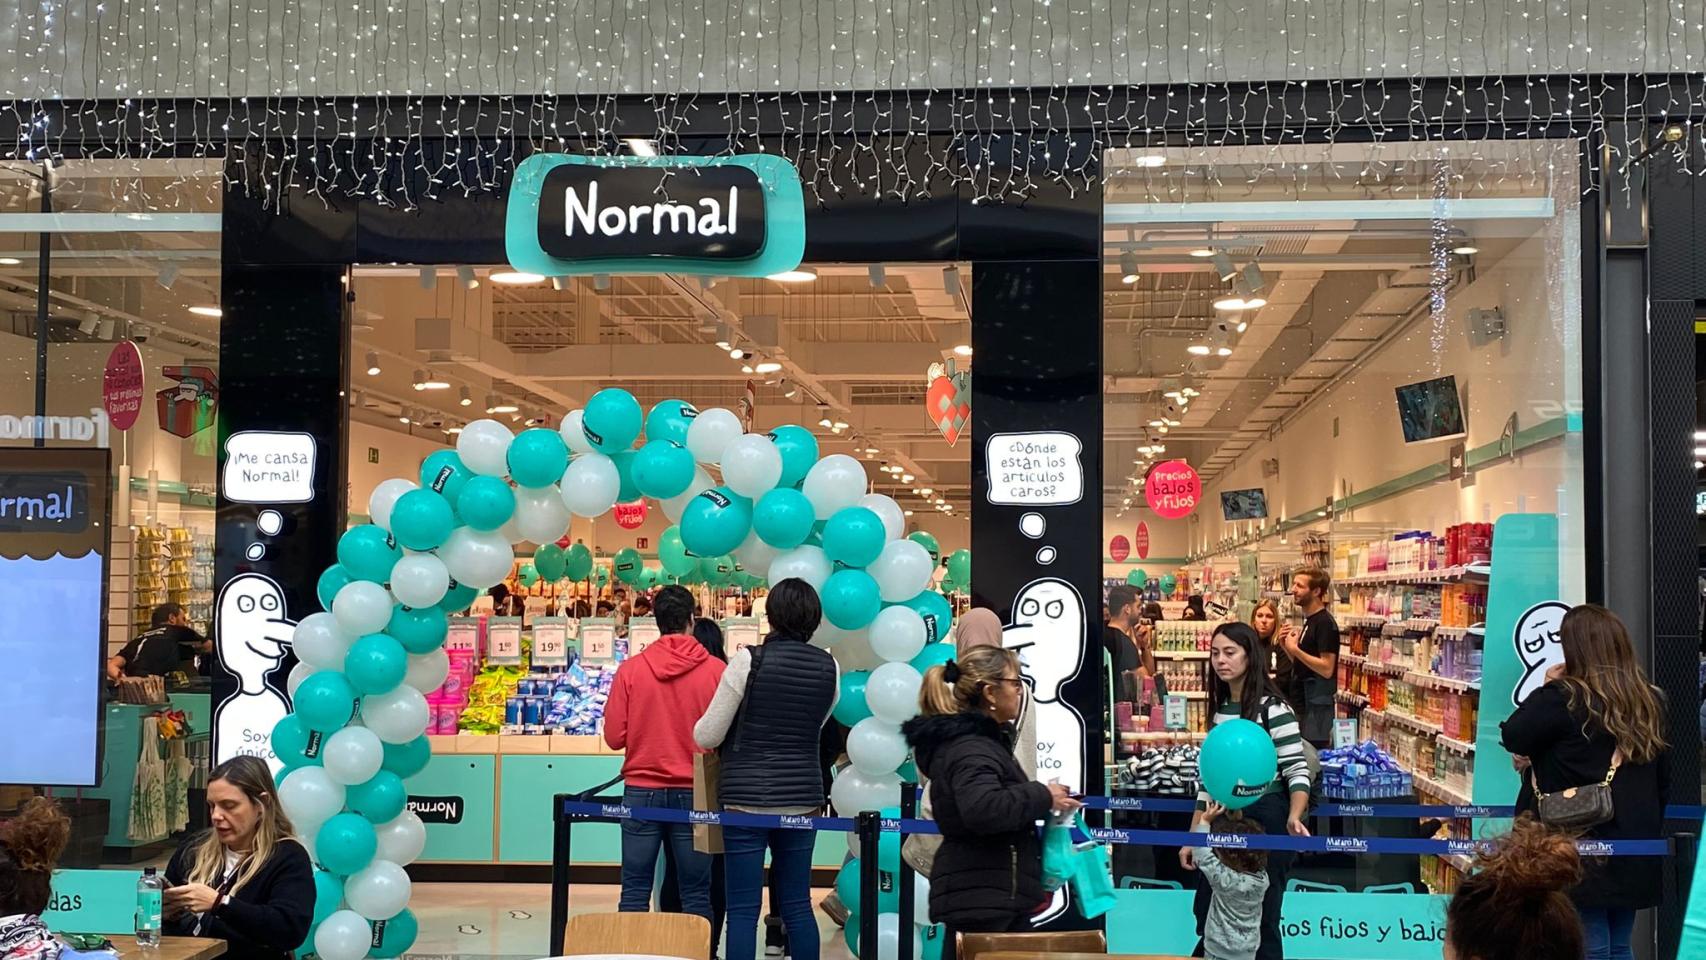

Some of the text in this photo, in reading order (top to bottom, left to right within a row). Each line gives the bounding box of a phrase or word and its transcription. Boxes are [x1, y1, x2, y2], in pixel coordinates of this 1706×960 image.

[565, 180, 737, 236] Normal
[234, 452, 308, 465] ¡Me cansa
[1001, 456, 1066, 469] están los
[242, 468, 299, 482] Normal!
[1010, 485, 1056, 497] caros?
[1152, 481, 1193, 495] bajos
[0, 486, 73, 518] rmal
[242, 728, 271, 744] Soy
[1036, 741, 1056, 753] oy
[1036, 755, 1062, 768] ico
[407, 802, 456, 819] Norma
[1232, 835, 1248, 843] Parc
[1352, 838, 1368, 847] Parc
[46, 891, 82, 911] das
[1281, 916, 1447, 943] ios fijos y bajo
